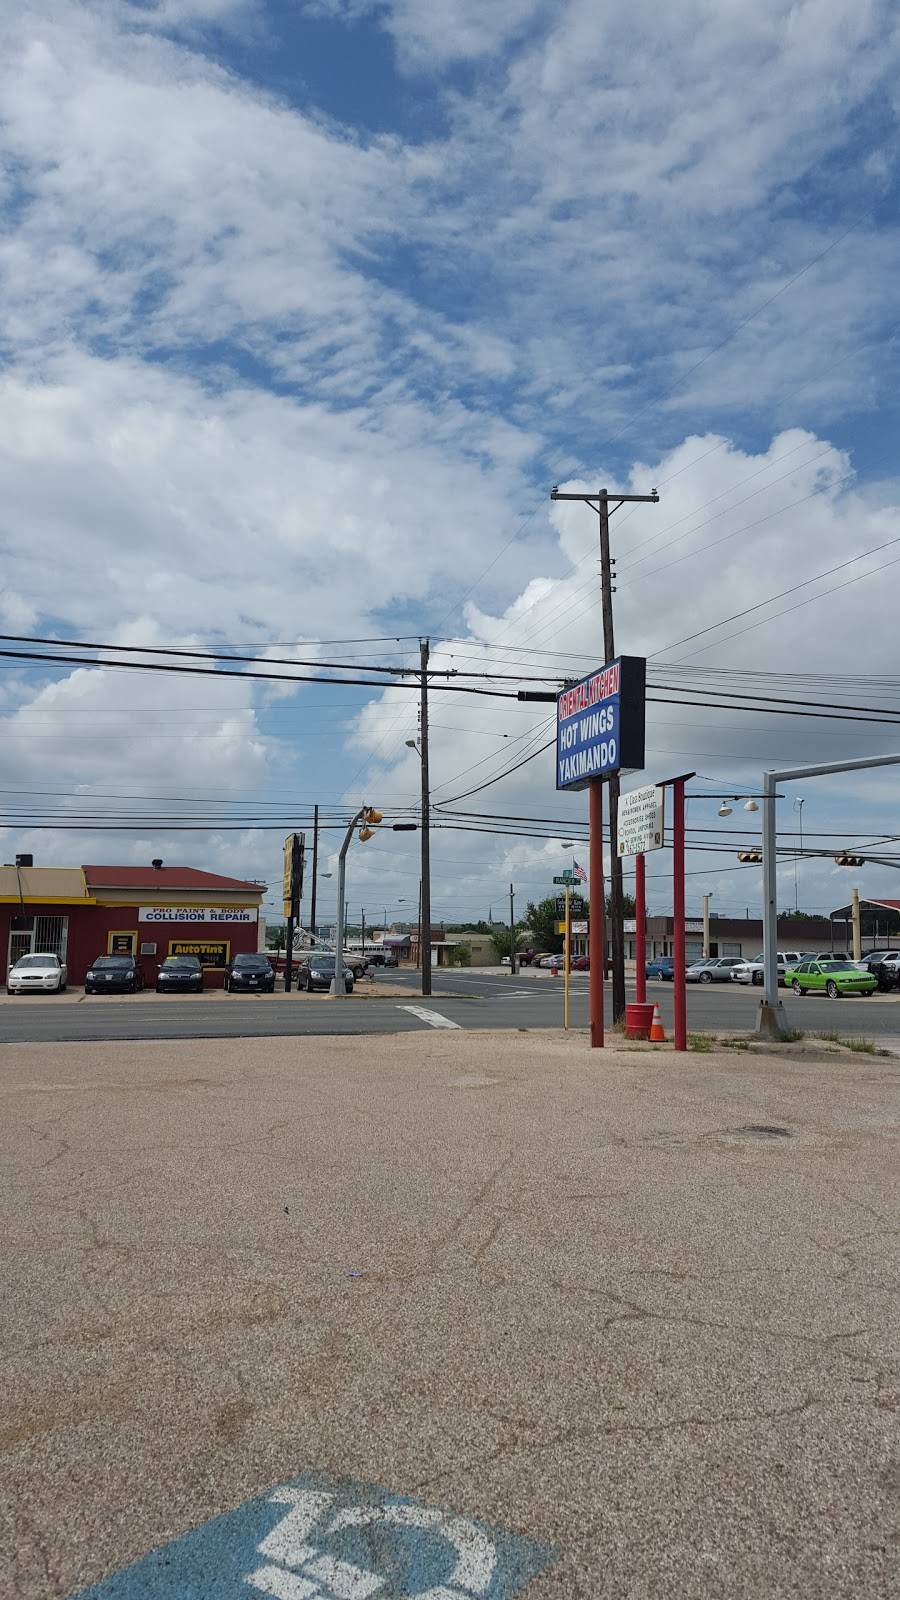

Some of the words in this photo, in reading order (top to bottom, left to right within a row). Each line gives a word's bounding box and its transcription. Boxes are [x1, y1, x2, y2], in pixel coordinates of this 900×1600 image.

[559, 682, 587, 720] ORIENTAL
[589, 664, 620, 706] KITCHEN
[560, 722, 578, 752] HOT
[580, 705, 614, 742] WINGS
[559, 738, 616, 782] YAKIMANDO
[145, 913, 205, 921] COLLISION
[210, 913, 250, 921] REPAIR
